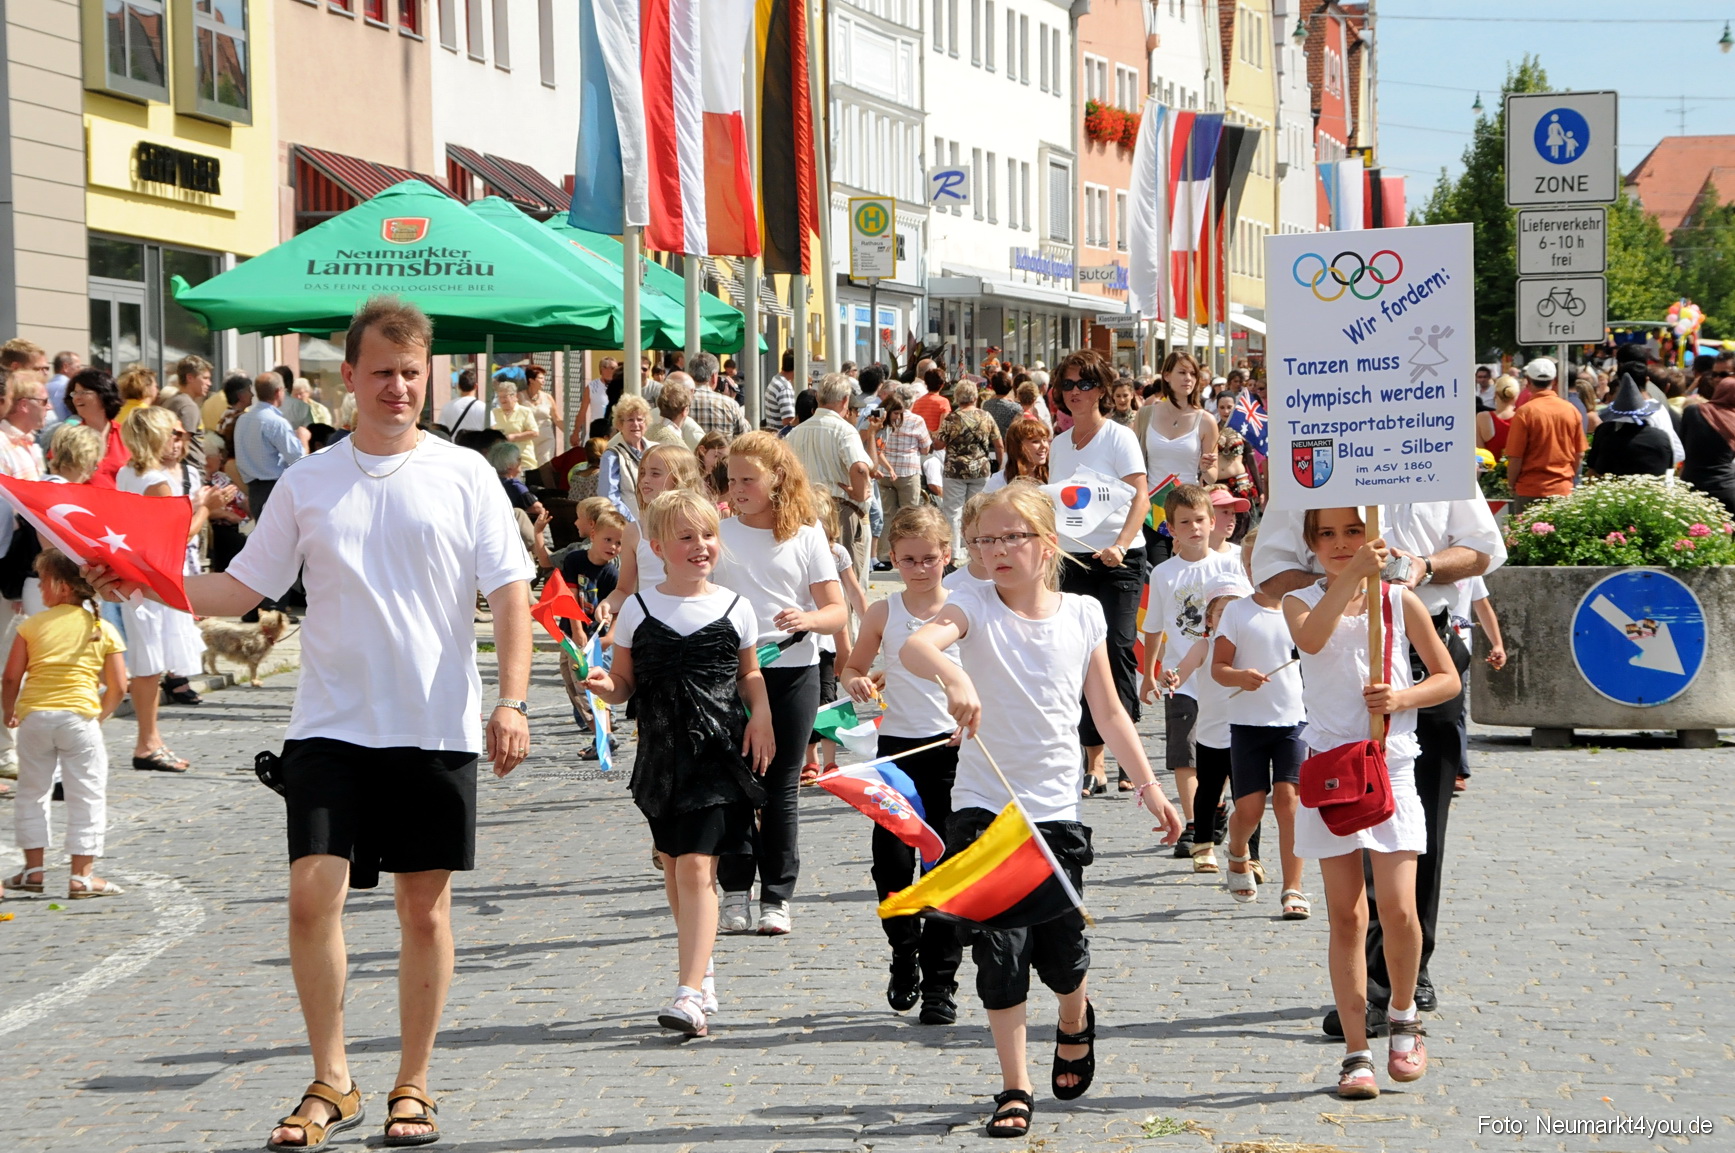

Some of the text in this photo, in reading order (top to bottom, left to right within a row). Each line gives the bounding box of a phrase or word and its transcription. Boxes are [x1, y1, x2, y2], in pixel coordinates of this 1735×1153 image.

[1535, 175, 1589, 194] ZONE
[864, 210, 880, 229] H
[1522, 217, 1602, 233] Lieferverkehr
[336, 247, 471, 260] Neumarkter
[1551, 253, 1572, 267] frei
[306, 259, 494, 277] Lammsbräu
[334, 283, 367, 291] FEINE
[372, 282, 464, 292] ÖKOLOGISCHE
[1342, 267, 1451, 345] Wir fordern:
[1099, 315, 1132, 323] Klostergasse
[1548, 321, 1575, 335] frei
[1283, 355, 1400, 376] Tanzen muss
[1286, 384, 1372, 413] olympisch
[1380, 382, 1445, 402] werden
[1288, 412, 1455, 437] Tanzsportabteilung
[1292, 439, 1333, 448] NEUMARKT
[1338, 442, 1374, 459] Blau
[1401, 439, 1453, 455] Silber
[1356, 460, 1432, 473] im ASV 1860
[1355, 473, 1440, 487] Neumarkt e.V.
